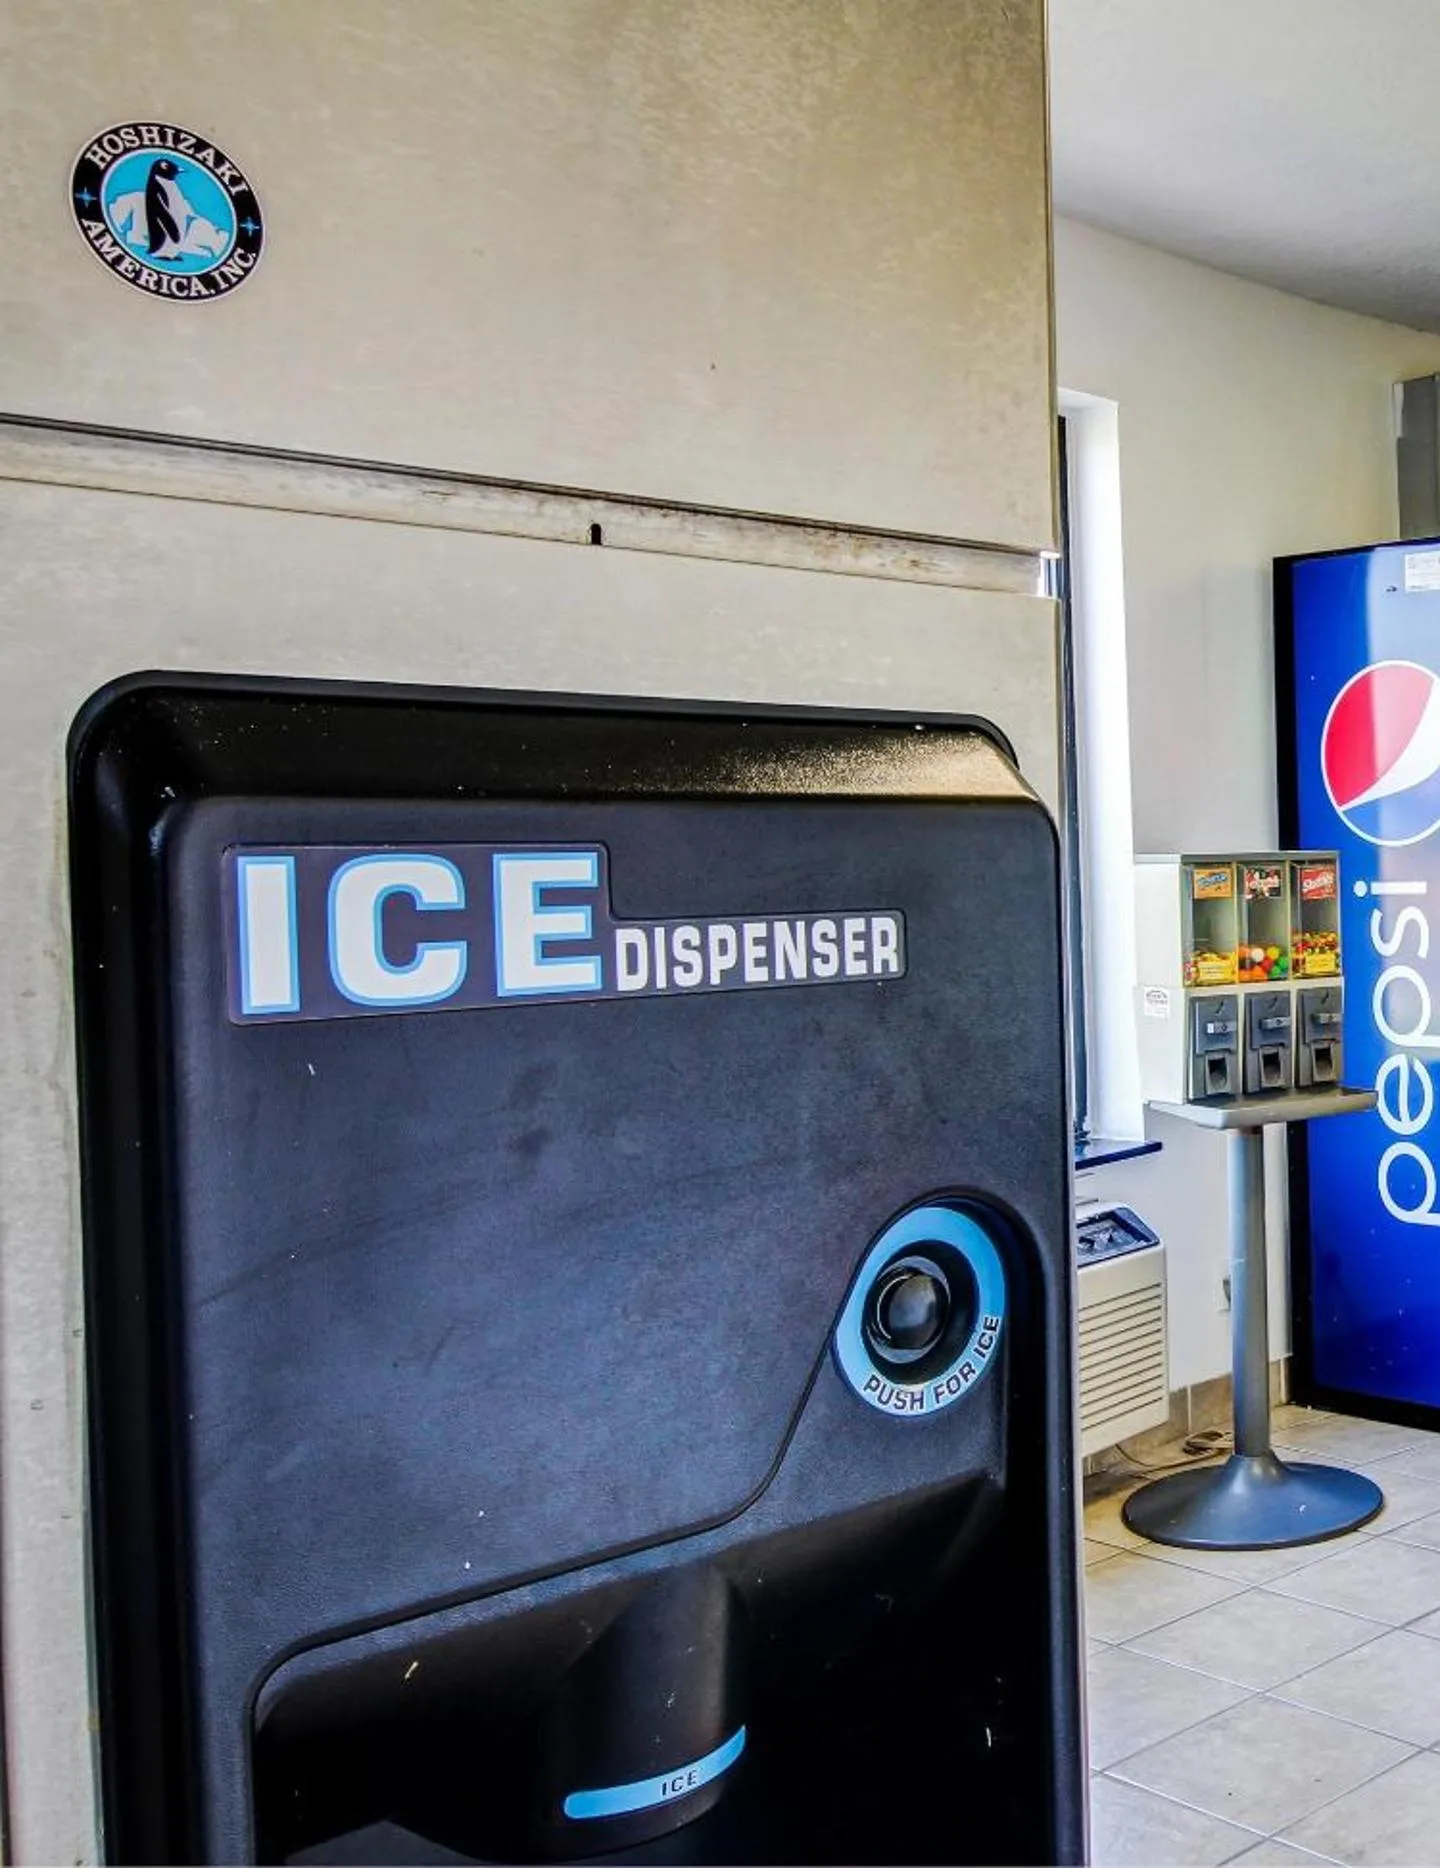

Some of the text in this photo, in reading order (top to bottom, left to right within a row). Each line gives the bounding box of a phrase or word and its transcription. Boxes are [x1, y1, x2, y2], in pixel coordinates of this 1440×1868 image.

[83, 125, 249, 196] HOSHIZAKI
[236, 851, 901, 1015] ICE DISPENSER
[863, 1316, 1000, 1411] PUSH FOR ICE
[661, 1769, 699, 1796] ICE
